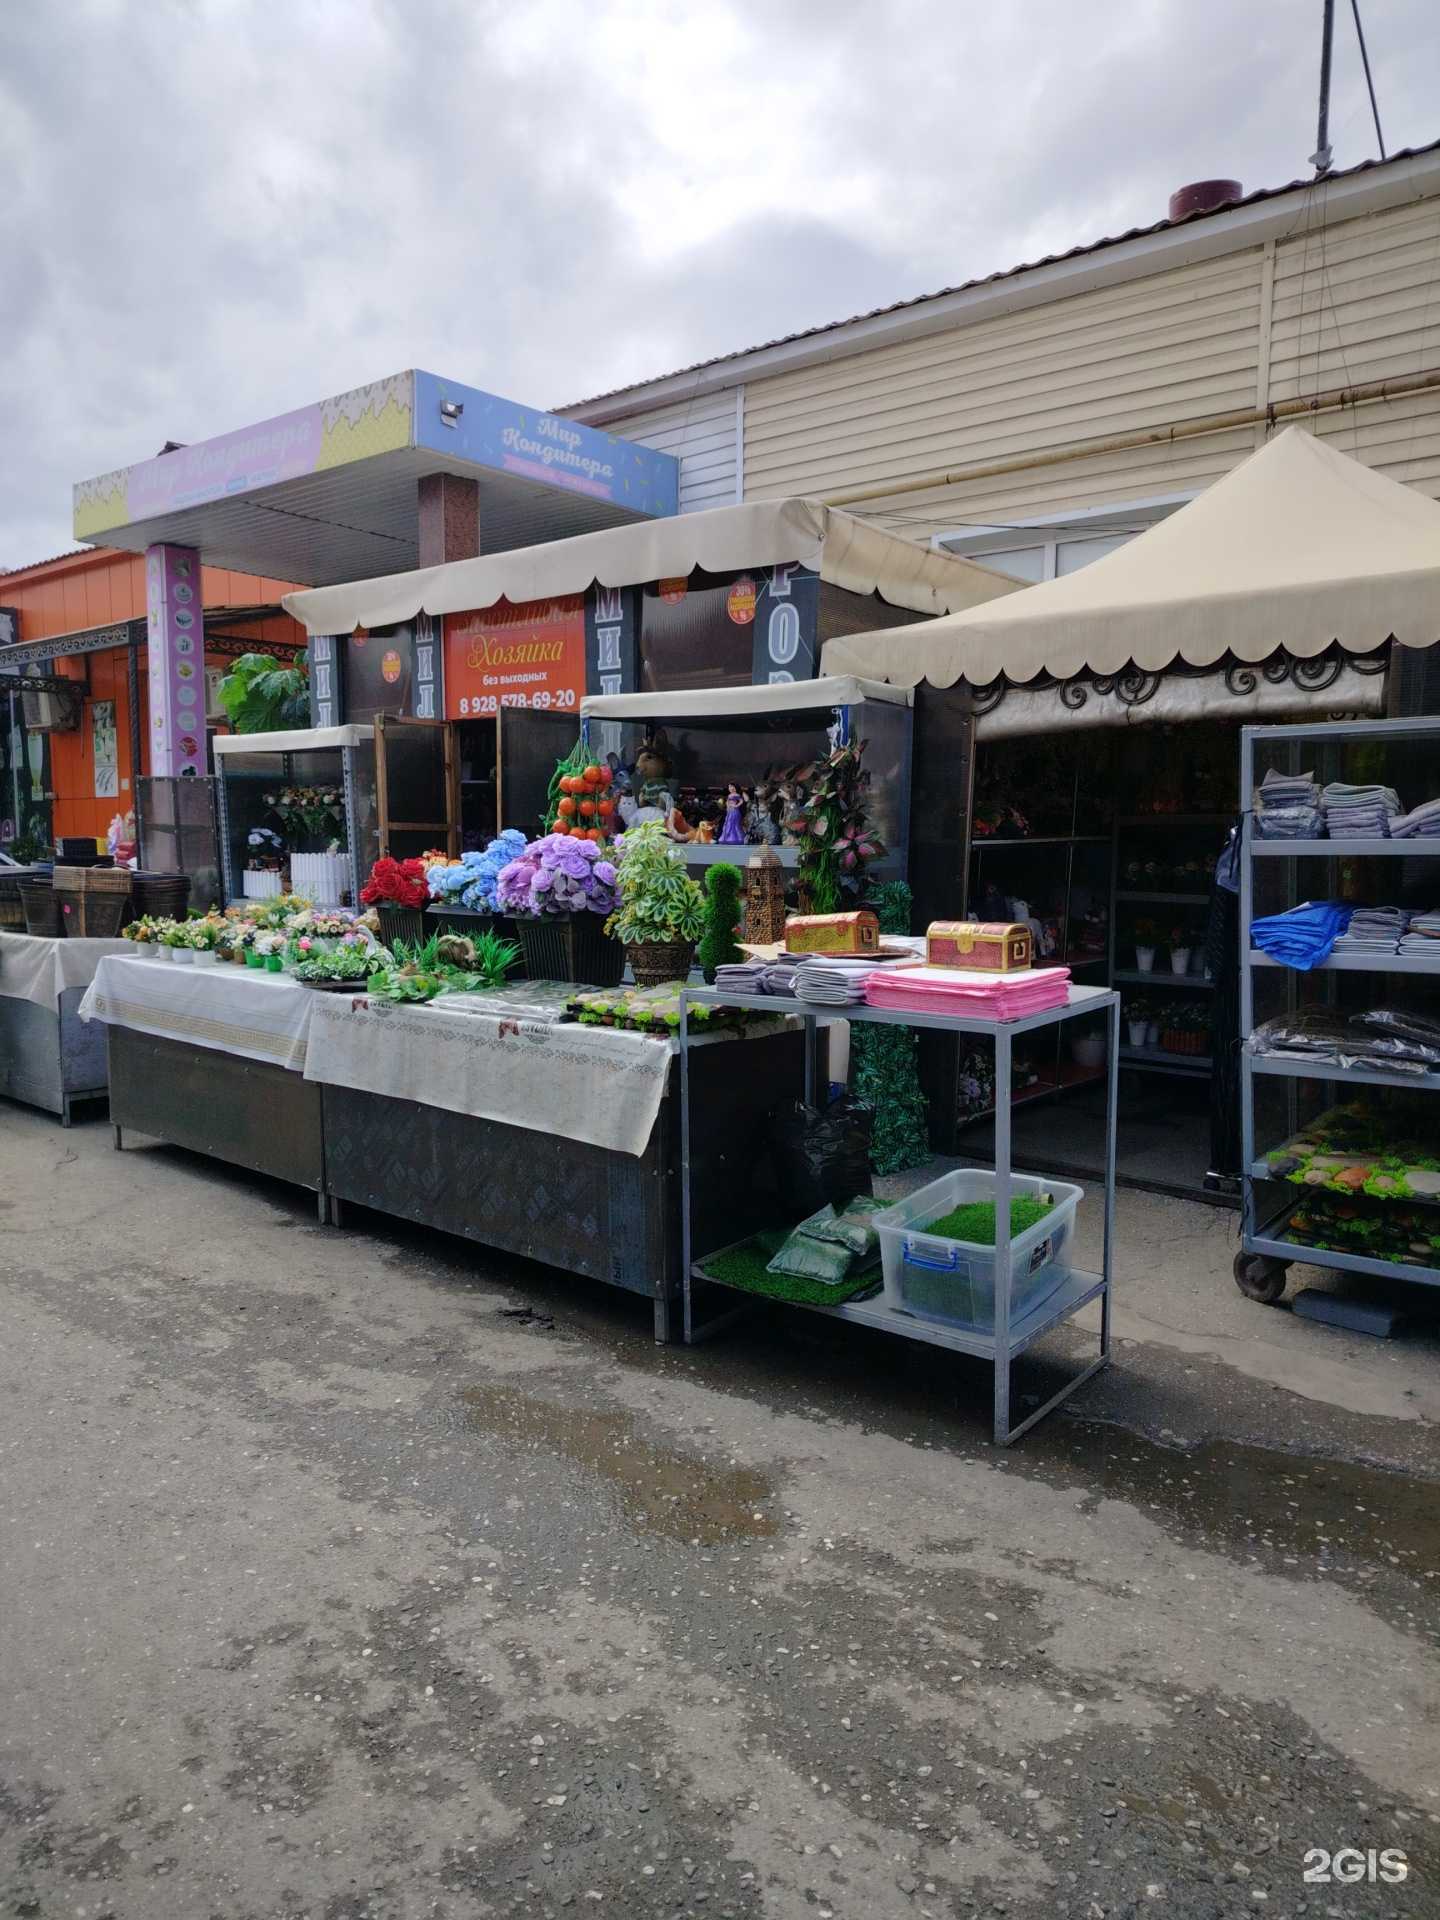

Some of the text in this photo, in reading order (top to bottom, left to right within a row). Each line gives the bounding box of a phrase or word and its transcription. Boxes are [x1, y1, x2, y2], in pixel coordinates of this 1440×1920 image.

[536, 418, 583, 451] Мир
[502, 427, 614, 479] Кондитера
[467, 634, 564, 673] Хозяйка
[483, 671, 547, 686] без выходных
[460, 689, 575, 714] 8 928 578-69-20
